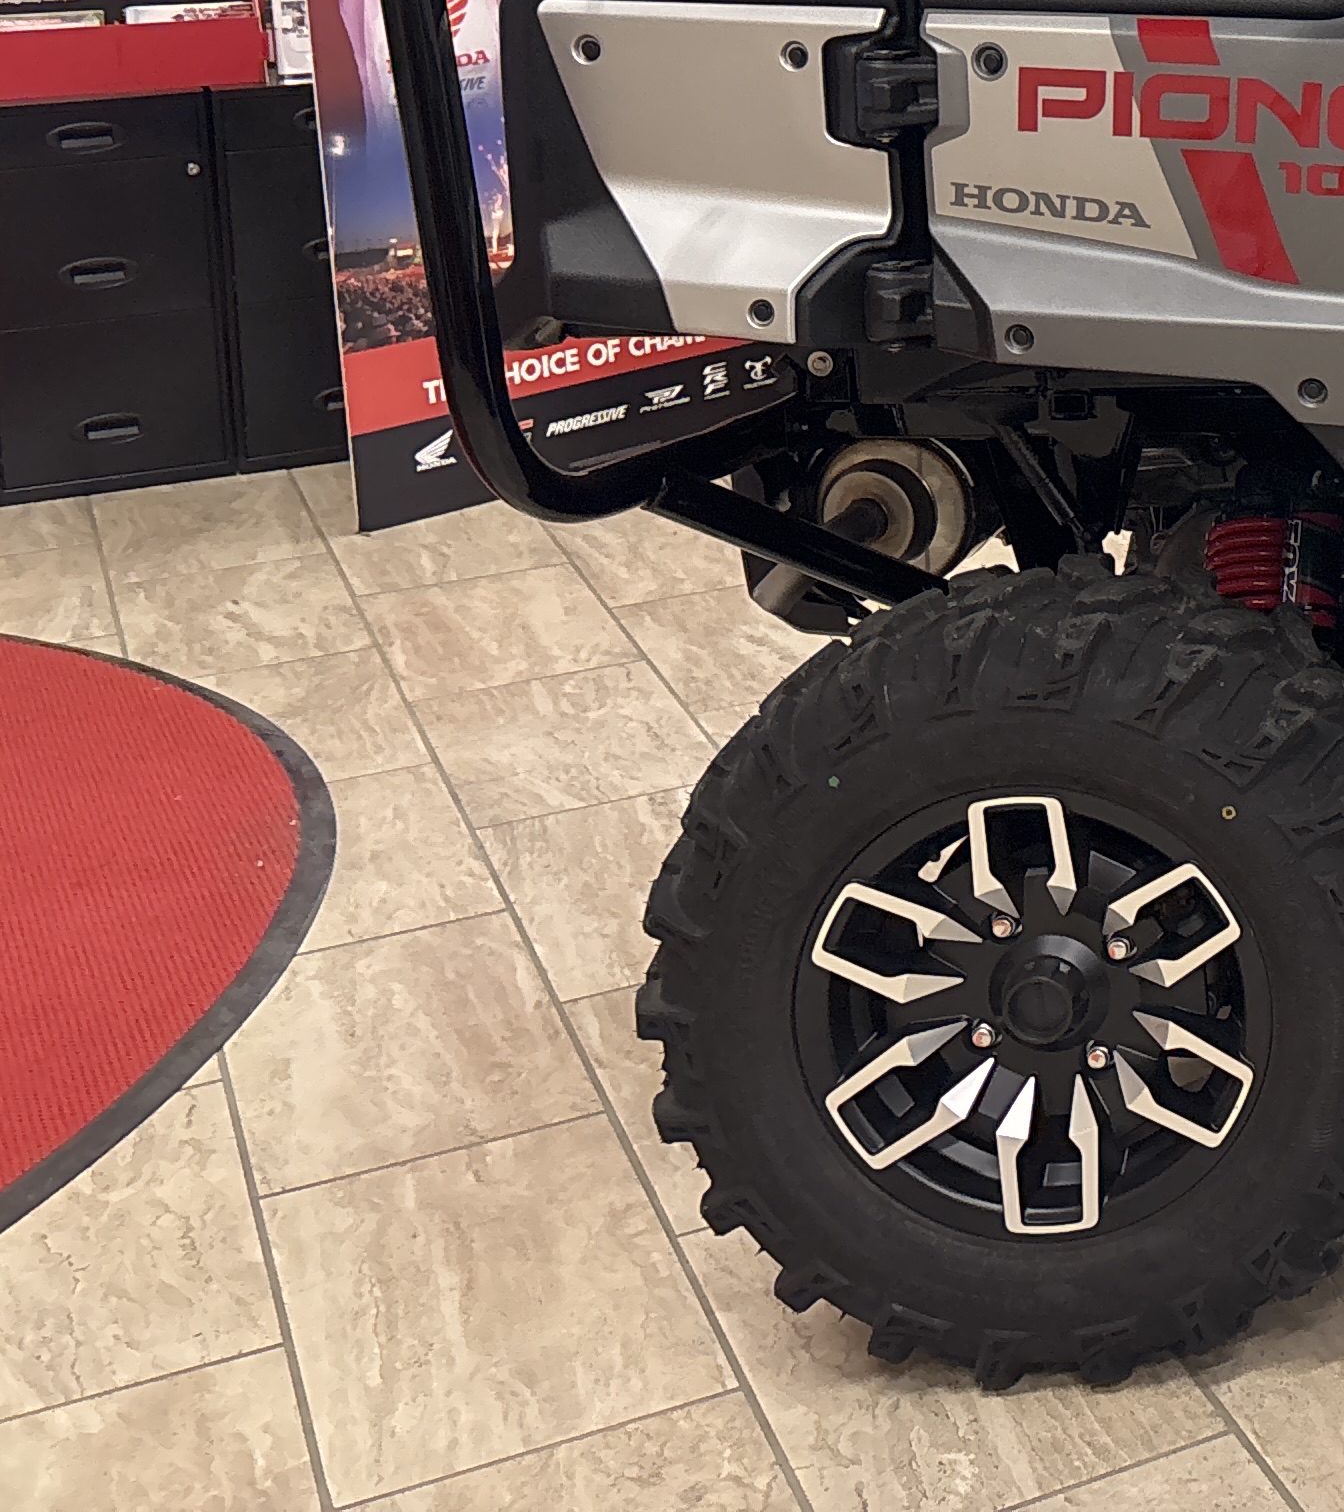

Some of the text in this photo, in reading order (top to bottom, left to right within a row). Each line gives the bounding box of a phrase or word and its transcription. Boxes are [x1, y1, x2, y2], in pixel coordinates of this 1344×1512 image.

[950, 181, 1152, 229] HONDA
[505, 347, 581, 386] HOICE
[586, 338, 621, 367] OF
[545, 404, 629, 438] PROGRESSIVE
[416, 456, 458, 473] HONDA
